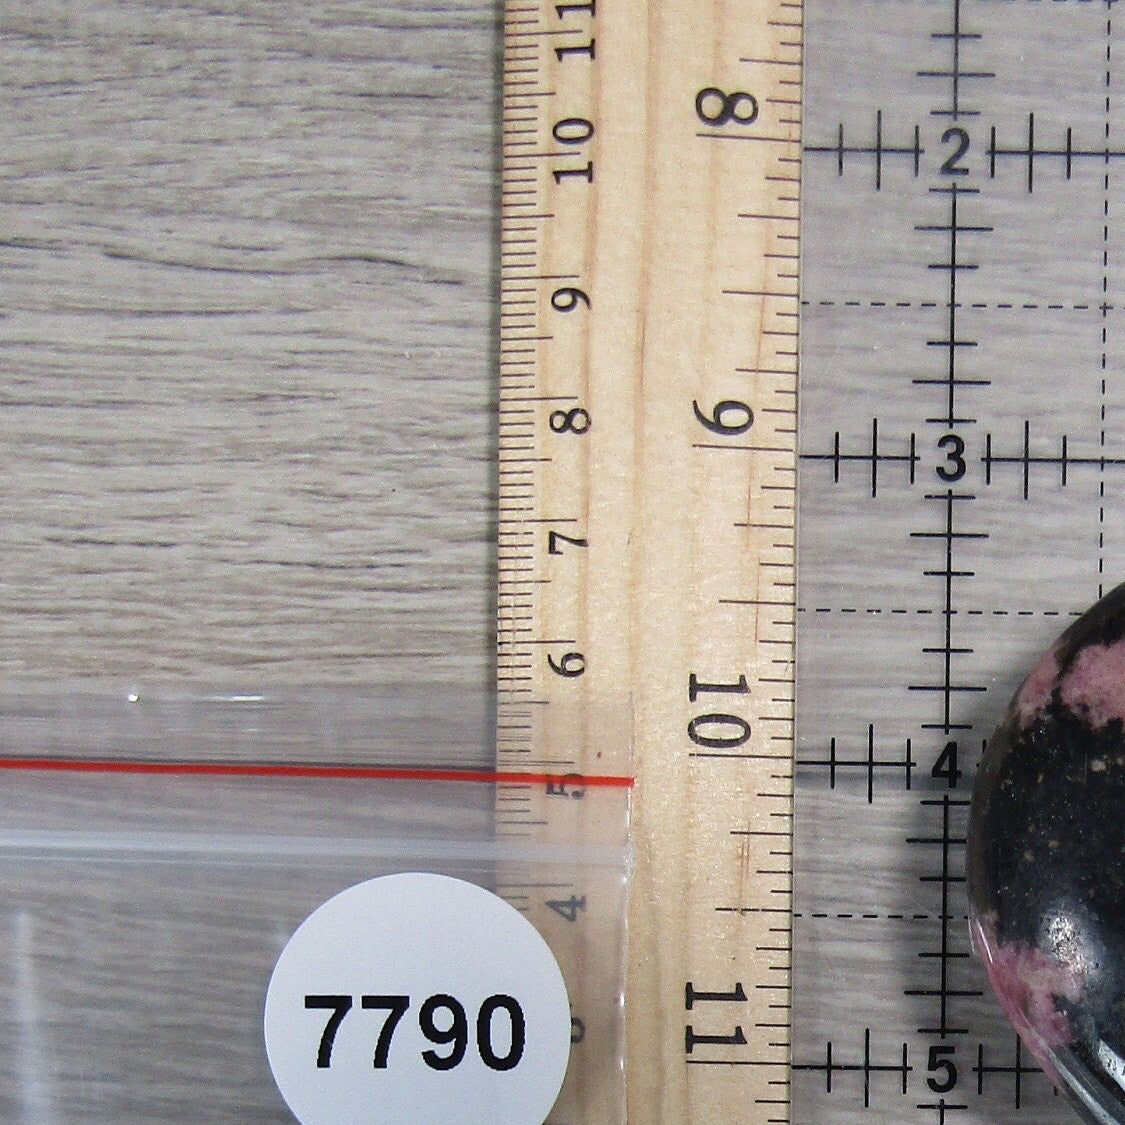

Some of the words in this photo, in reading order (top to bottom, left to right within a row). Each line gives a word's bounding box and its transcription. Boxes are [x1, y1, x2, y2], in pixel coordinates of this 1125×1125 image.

[552, 0, 596, 61] 11
[695, 87, 759, 127] 8
[551, 118, 594, 185] 10
[939, 127, 970, 176] 2
[550, 287, 591, 313] 9
[549, 407, 592, 435] 8
[692, 400, 755, 436] 9
[935, 434, 967, 482] 3
[548, 530, 589, 555] 7
[547, 652, 585, 678] 6
[687, 673, 752, 749] 10
[931, 742, 963, 789] 4
[544, 895, 586, 922] 4
[304, 993, 526, 1072] 7790
[684, 982, 749, 1055] 11
[926, 1045, 958, 1094] 5
